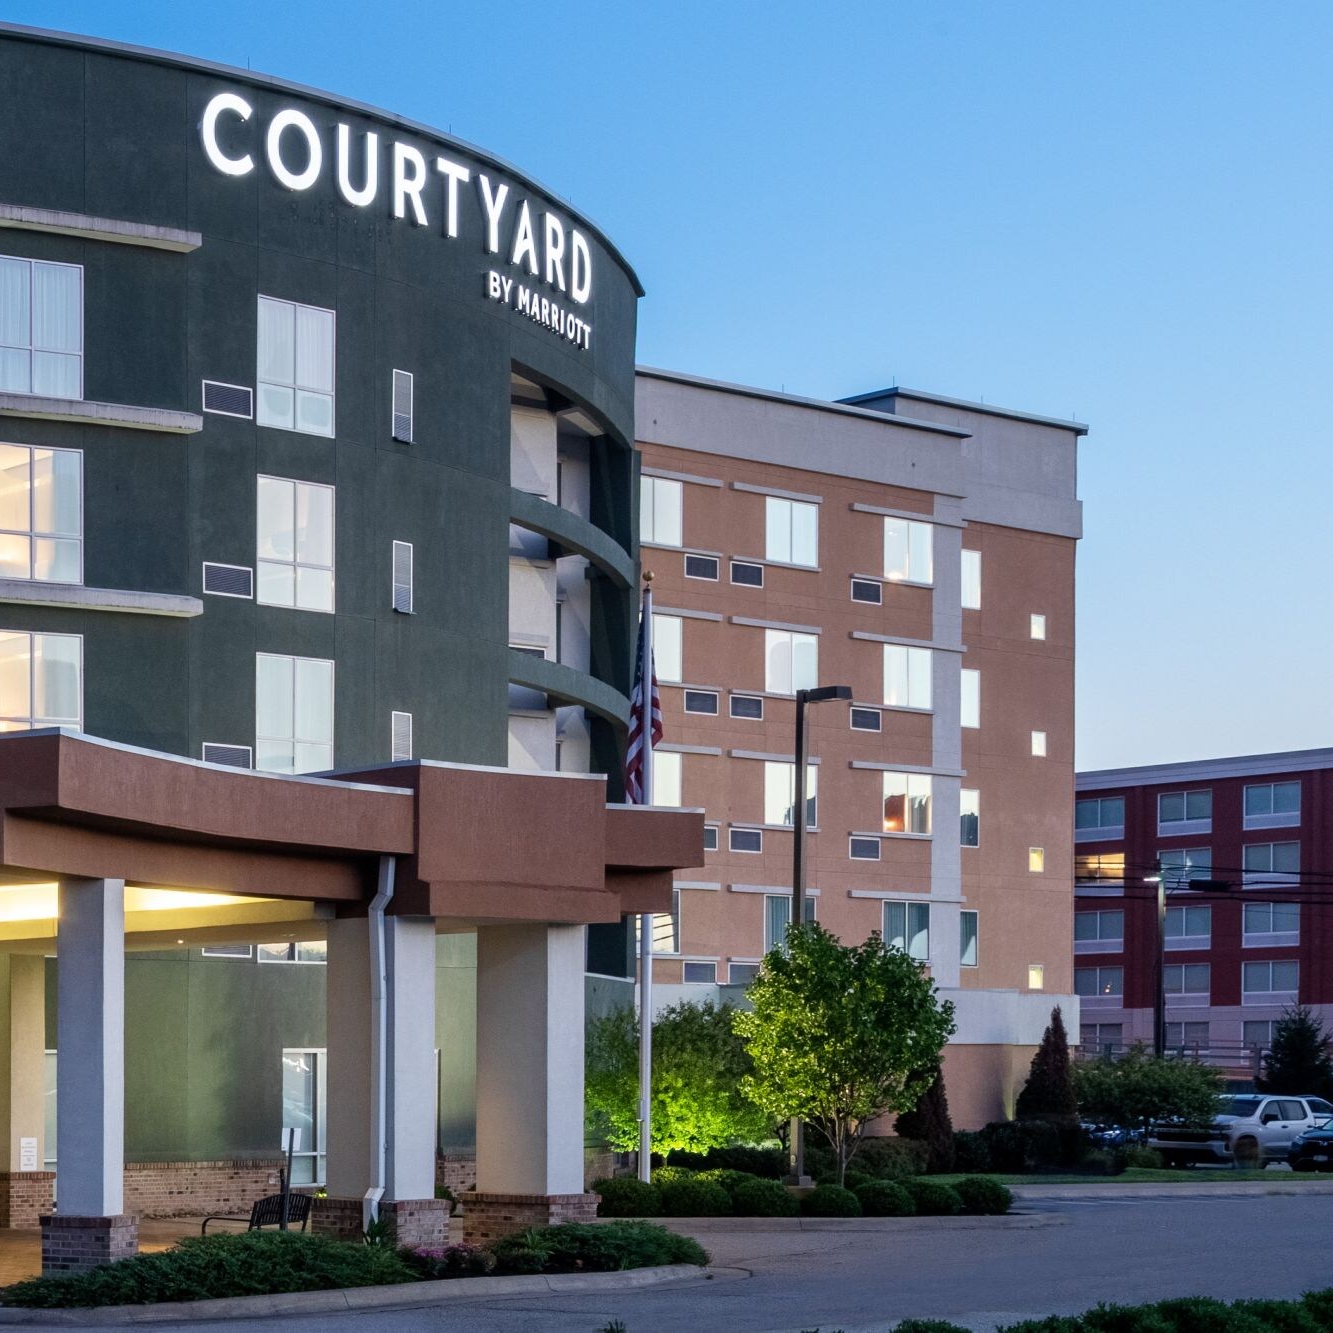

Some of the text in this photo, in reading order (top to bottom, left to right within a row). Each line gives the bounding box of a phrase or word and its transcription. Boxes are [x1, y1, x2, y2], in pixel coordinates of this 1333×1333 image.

[202, 93, 592, 304] COURTYARD
[489, 270, 591, 350] BY MARRIOTT
